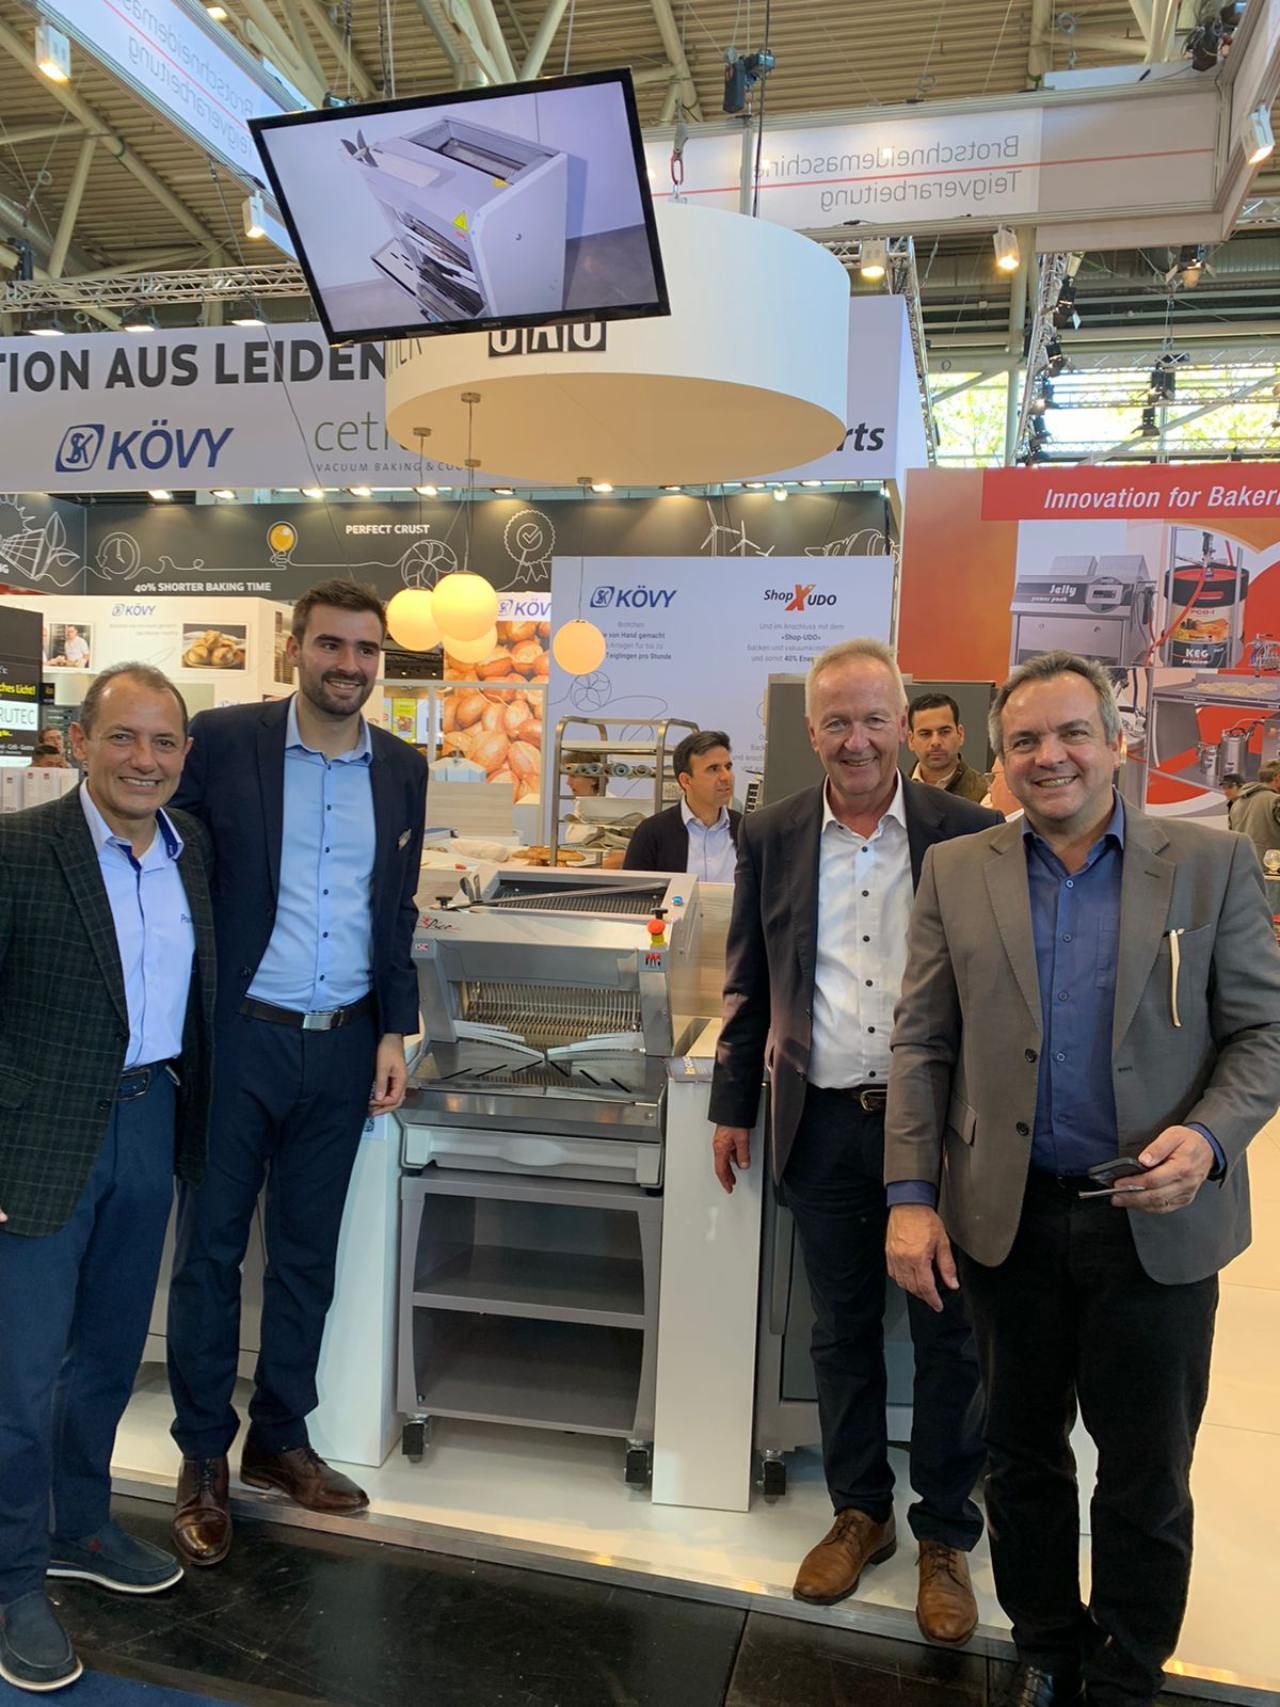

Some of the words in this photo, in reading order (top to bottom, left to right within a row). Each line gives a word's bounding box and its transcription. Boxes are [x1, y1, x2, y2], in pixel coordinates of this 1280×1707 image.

[105, 344, 198, 389] AUS
[107, 419, 234, 470] KÖVY
[316, 463, 368, 472] VACUUM
[374, 463, 421, 472] BAKING
[426, 462, 434, 472] &
[1044, 489, 1160, 509] Innovation
[1168, 487, 1201, 508] for
[346, 525, 392, 534] PERFECT
[394, 525, 430, 534] CRUST
[134, 583, 156, 592] 40%
[158, 582, 204, 592] SHORTER
[205, 582, 244, 592] BAKING
[247, 582, 271, 591] TIME
[1050, 584, 1077, 597] Jelly
[616, 585, 677, 608] KÖVY
[1185, 649, 1209, 658] KEG
